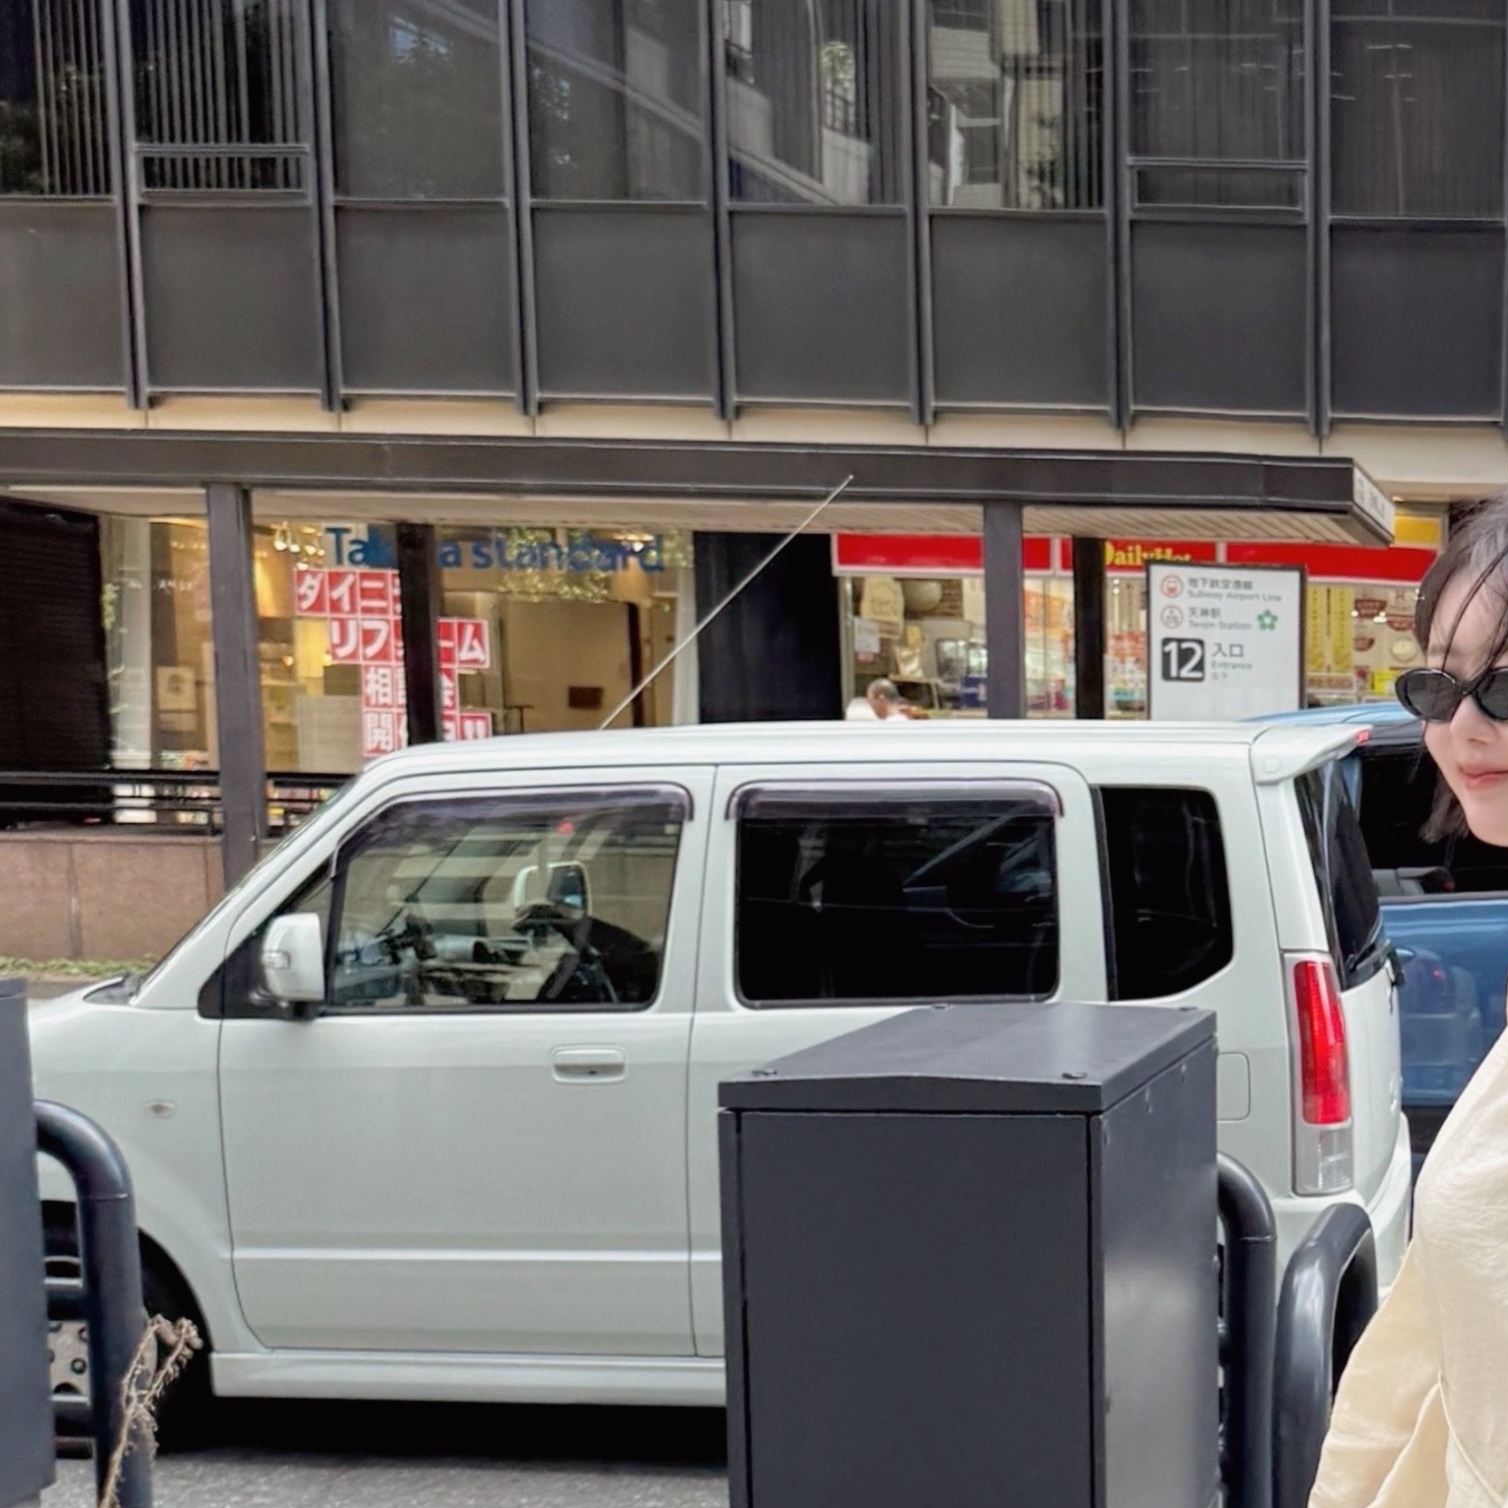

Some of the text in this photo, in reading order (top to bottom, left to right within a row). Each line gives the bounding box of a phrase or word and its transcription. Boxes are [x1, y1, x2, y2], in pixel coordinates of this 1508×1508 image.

[299, 572, 401, 613] ダイニ
[330, 619, 486, 663] リフーム
[1163, 640, 1204, 679] 12
[1211, 642, 1245, 658] 入口
